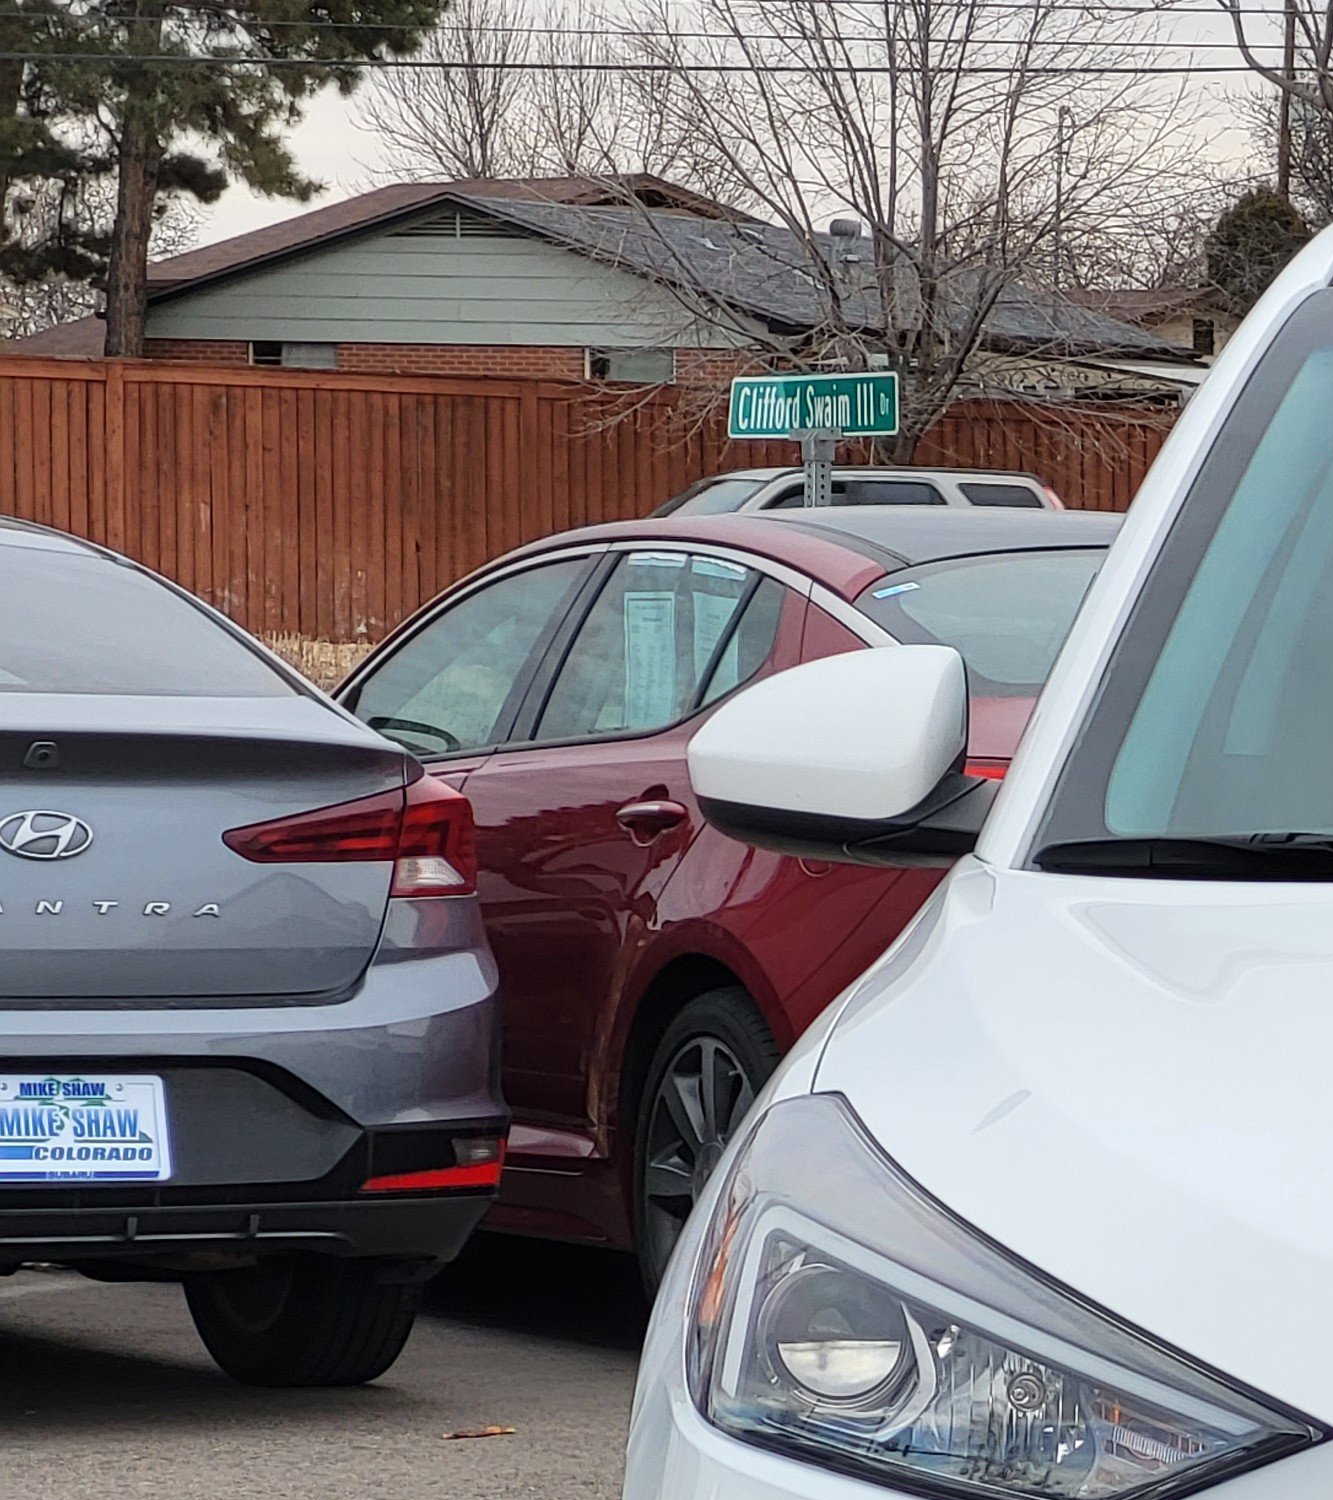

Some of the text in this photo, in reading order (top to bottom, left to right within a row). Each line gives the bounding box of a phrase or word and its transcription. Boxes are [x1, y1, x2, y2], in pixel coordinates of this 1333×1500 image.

[738, 382, 890, 430] Clifford Swaim III Dr
[0, 900, 220, 918] NTRA
[19, 1082, 105, 1096] MIKE SHAW
[0, 1107, 139, 1138] MIKE SHAW
[34, 1146, 153, 1161] COLORADO
[48, 1171, 93, 1179] SUBARU
